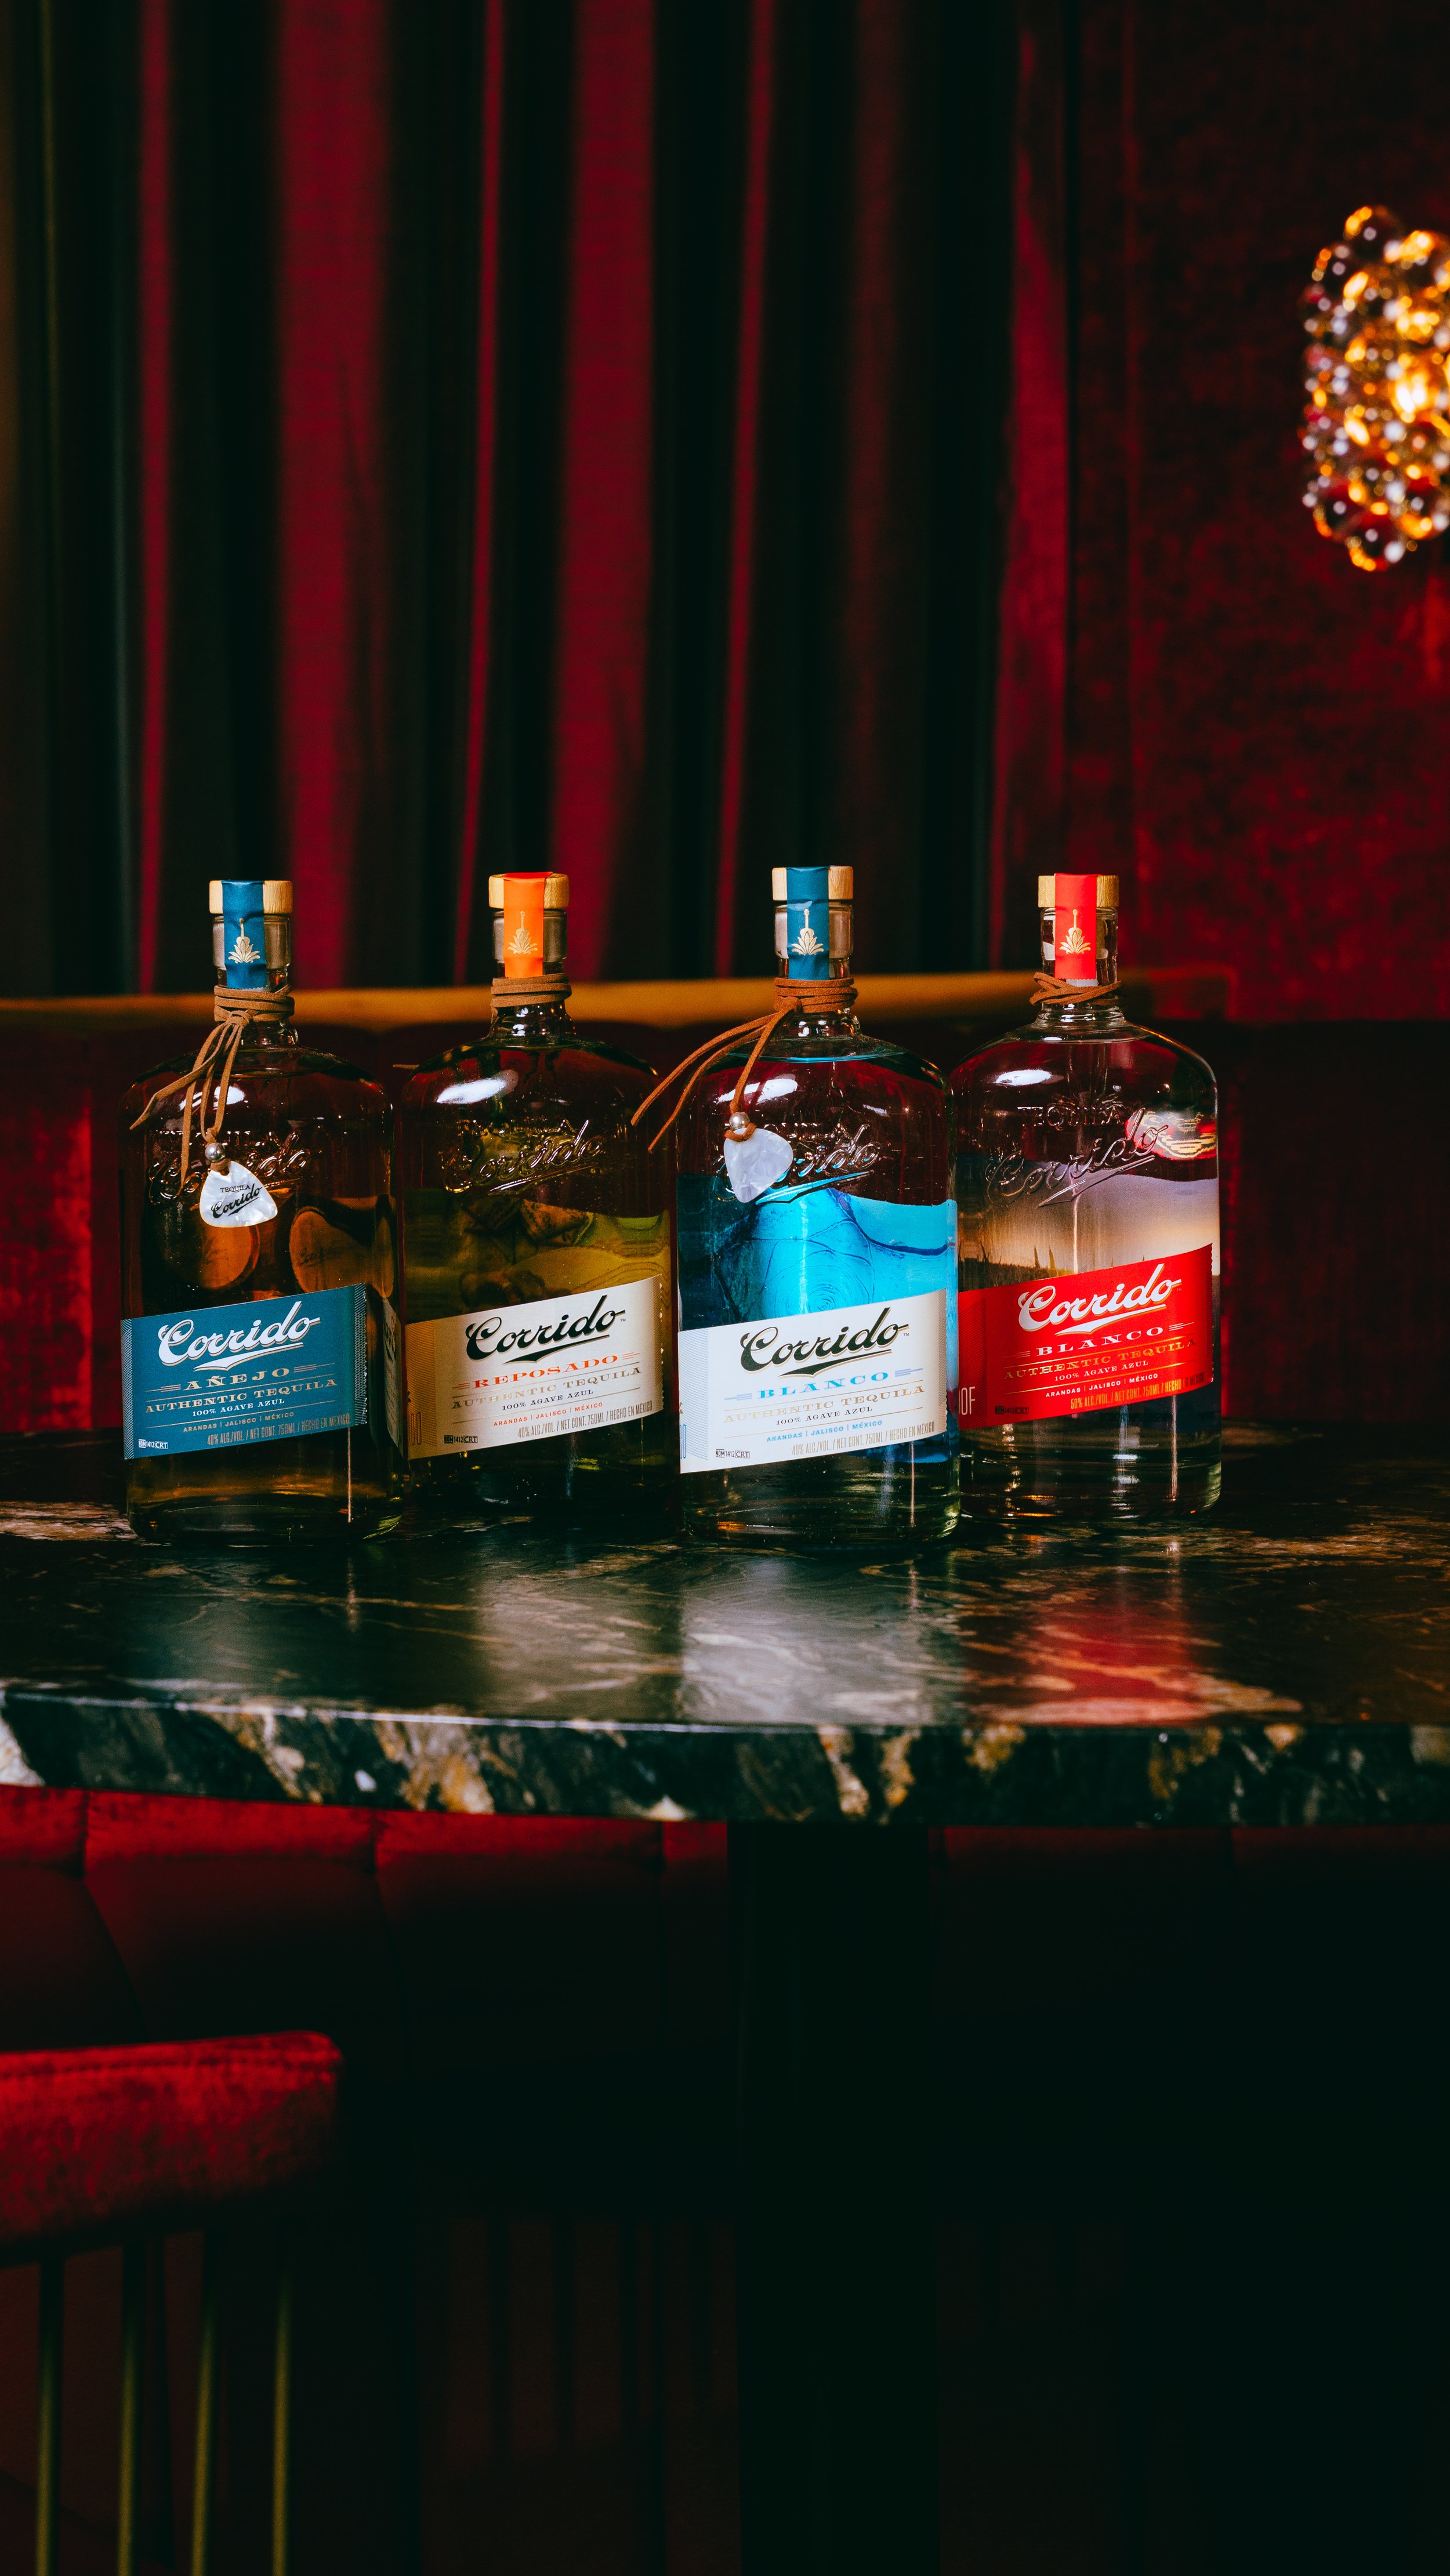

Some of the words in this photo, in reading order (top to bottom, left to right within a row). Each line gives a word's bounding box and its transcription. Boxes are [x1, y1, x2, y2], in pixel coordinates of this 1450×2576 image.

[985, 1108, 1168, 1207] Corrido
[211, 1183, 262, 1218] Corrido
[1018, 1263, 1182, 1331] Corrido
[158, 1301, 321, 1366] Corrido
[465, 1294, 626, 1362] Corrido
[740, 1307, 909, 1373] Corrido
[1036, 1326, 1163, 1356] BLANCO
[472, 1355, 618, 1388] REPOSADO
[1003, 1355, 1111, 1380] AUTHENTIC
[1118, 1339, 1195, 1361] TEQUILA
[1054, 1372, 1079, 1381] 100%
[1083, 1366, 1118, 1377] AGAVE
[1121, 1360, 1148, 1370] AZUL
[183, 1367, 289, 1391] AÑEJO
[452, 1384, 557, 1409] AUTHENTIC
[563, 1367, 641, 1389] TEQUILA
[757, 1372, 889, 1399] BLANCO
[1046, 1387, 1081, 1398] ARANDAS
[1089, 1380, 1121, 1391] JALISCO
[1129, 1373, 1158, 1383] MÉXICO
[1071, 1398, 1083, 1409] 50%
[1115, 1390, 1125, 1402] NET
[1126, 1388, 1141, 1401] CONT.
[1143, 1385, 1160, 1397] 750ML
[1165, 1378, 1181, 1392] HECHO
[146, 1392, 247, 1413] AUTHENTIC
[253, 1379, 337, 1398] TEQUILA
[192, 1407, 216, 1416] 100%
[220, 1403, 253, 1413] AGAVE
[258, 1398, 285, 1407] AZUL
[502, 1401, 527, 1410] 100%
[531, 1395, 563, 1405] AGAVE
[567, 1389, 593, 1399] AZUL
[723, 1400, 834, 1423] AUTHENTIC
[841, 1386, 925, 1406] TEQUILA
[959, 1386, 975, 1415] OF
[183, 1423, 217, 1432] ARANDAS
[225, 1417, 256, 1427] JALISCO
[264, 1412, 294, 1421] MÉXICO
[494, 1416, 528, 1427] ARANDAS
[535, 1409, 567, 1419] JALISCO
[575, 1402, 603, 1412] MÉXICO
[518, 1427, 530, 1438] 40%
[560, 1420, 570, 1431] NET
[571, 1417, 586, 1428] CONT.
[588, 1414, 605, 1425] 750ML
[610, 1407, 627, 1421] HECHO
[628, 1406, 635, 1416] EN
[636, 1401, 652, 1414] MÉXICO
[776, 1417, 802, 1425] 100%
[806, 1410, 840, 1421] AGAVE
[845, 1406, 873, 1416] AZUL
[207, 1433, 219, 1445] 40%
[250, 1428, 260, 1439] NET
[261, 1425, 276, 1438] CONT.
[278, 1422, 295, 1436] 750ML
[302, 1418, 320, 1432] HECHO
[321, 1417, 328, 1428] EN
[767, 1432, 803, 1442] ARANDAS
[811, 1426, 843, 1435] JALISCO
[852, 1420, 882, 1429] MÉXICO
[792, 1445, 803, 1455] 40%
[837, 1437, 847, 1448] NET
[849, 1435, 864, 1447] CONT.
[865, 1433, 883, 1445] 750ML
[889, 1428, 907, 1441] HECHO
[909, 1427, 915, 1436] EN
[917, 1421, 935, 1435] MÉXICO
